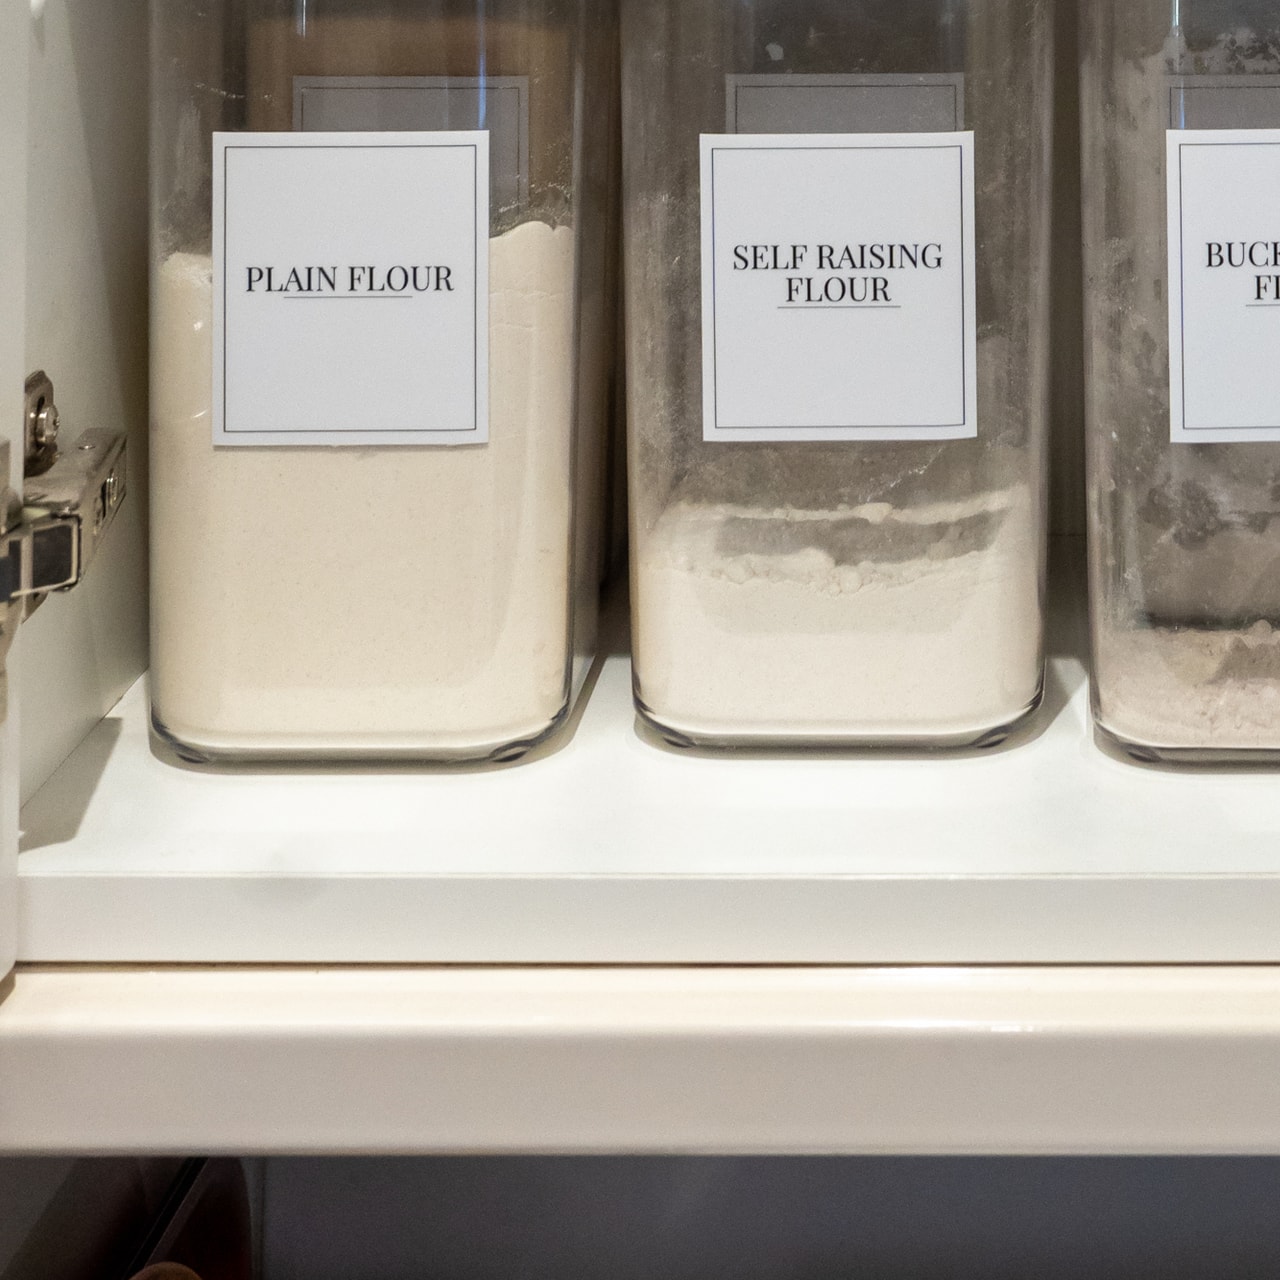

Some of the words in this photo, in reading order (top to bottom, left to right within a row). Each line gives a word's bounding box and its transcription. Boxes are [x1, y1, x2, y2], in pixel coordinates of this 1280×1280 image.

[733, 244, 807, 271] SELF
[817, 243, 942, 270] RAISING
[246, 266, 337, 292] PLAIN
[348, 265, 454, 292] FLOUR
[786, 276, 892, 303] FLOUR
